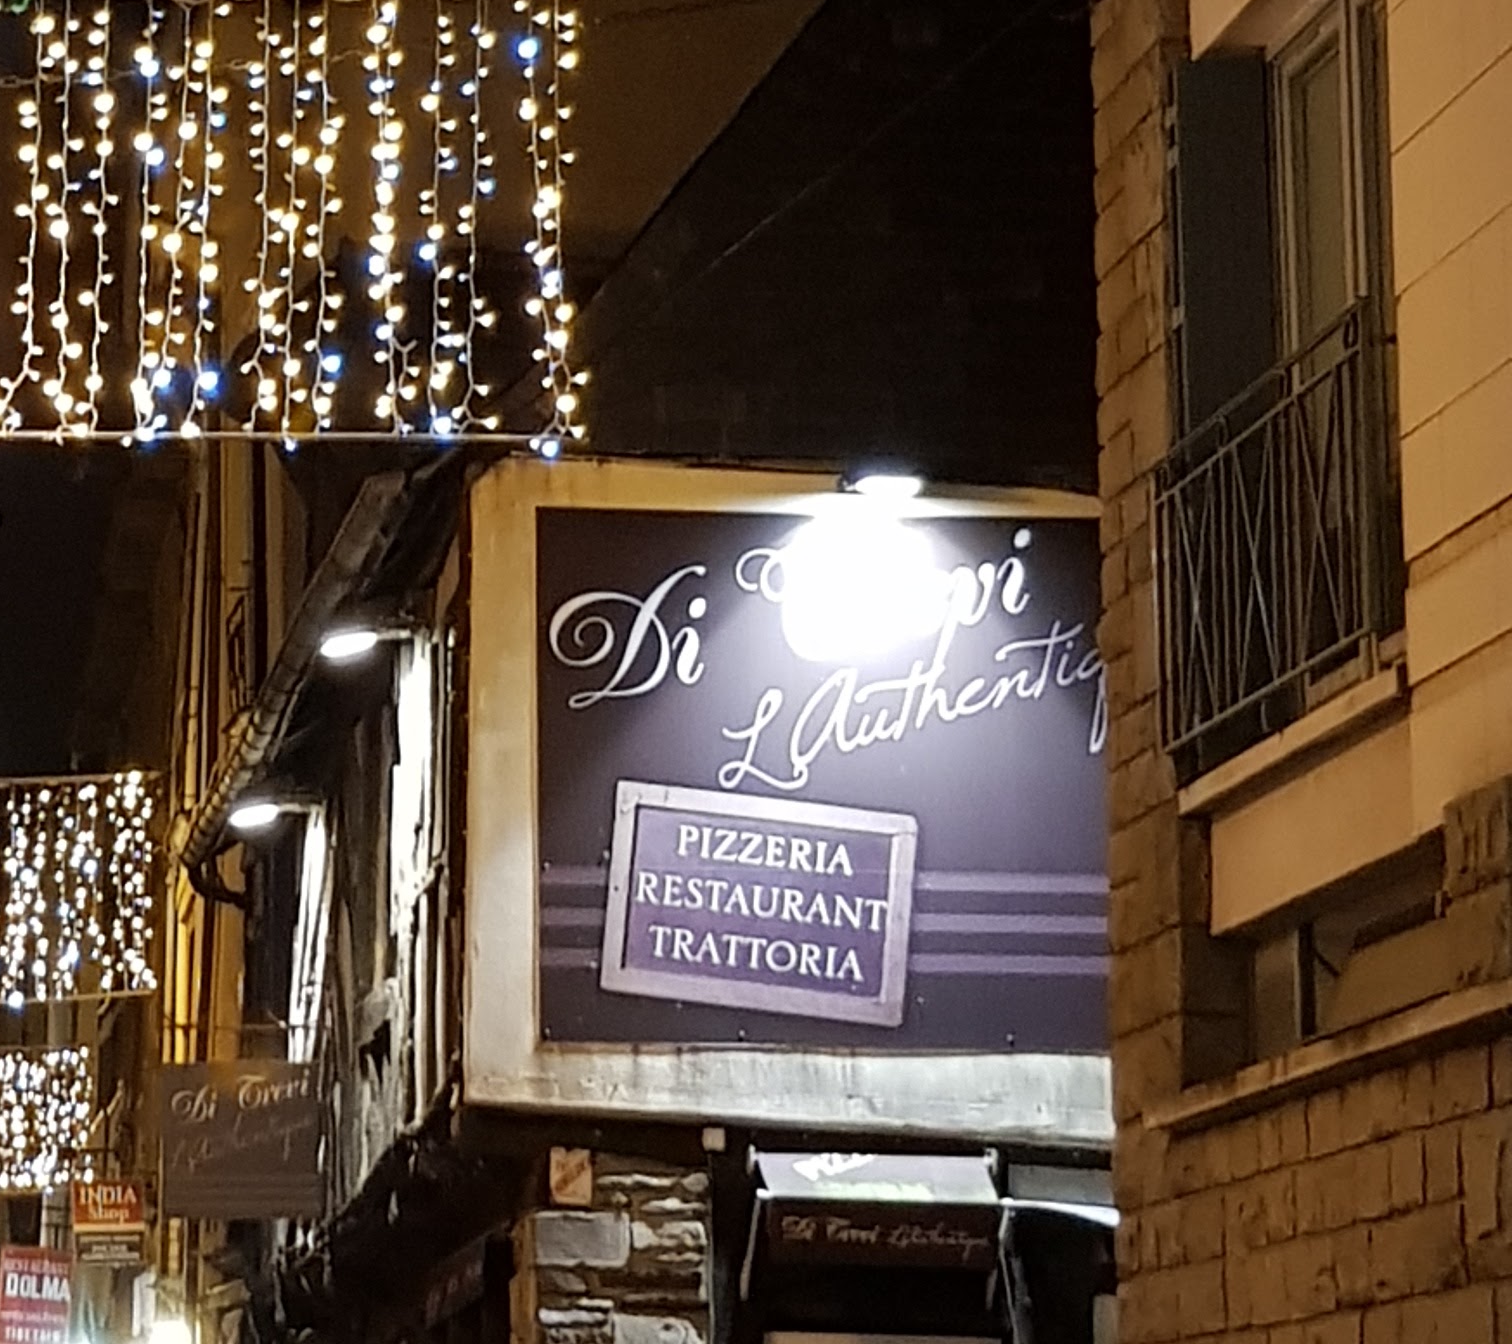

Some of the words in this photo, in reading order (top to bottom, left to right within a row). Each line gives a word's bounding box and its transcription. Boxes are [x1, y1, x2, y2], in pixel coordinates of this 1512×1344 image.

[549, 565, 707, 709] Di
[677, 824, 854, 877] PIZZERIA
[636, 871, 888, 932] RESTAURANT
[649, 924, 864, 982] TRATTORIA
[79, 1184, 137, 1205] INDIA
[6, 1272, 71, 1302] DOLMA
